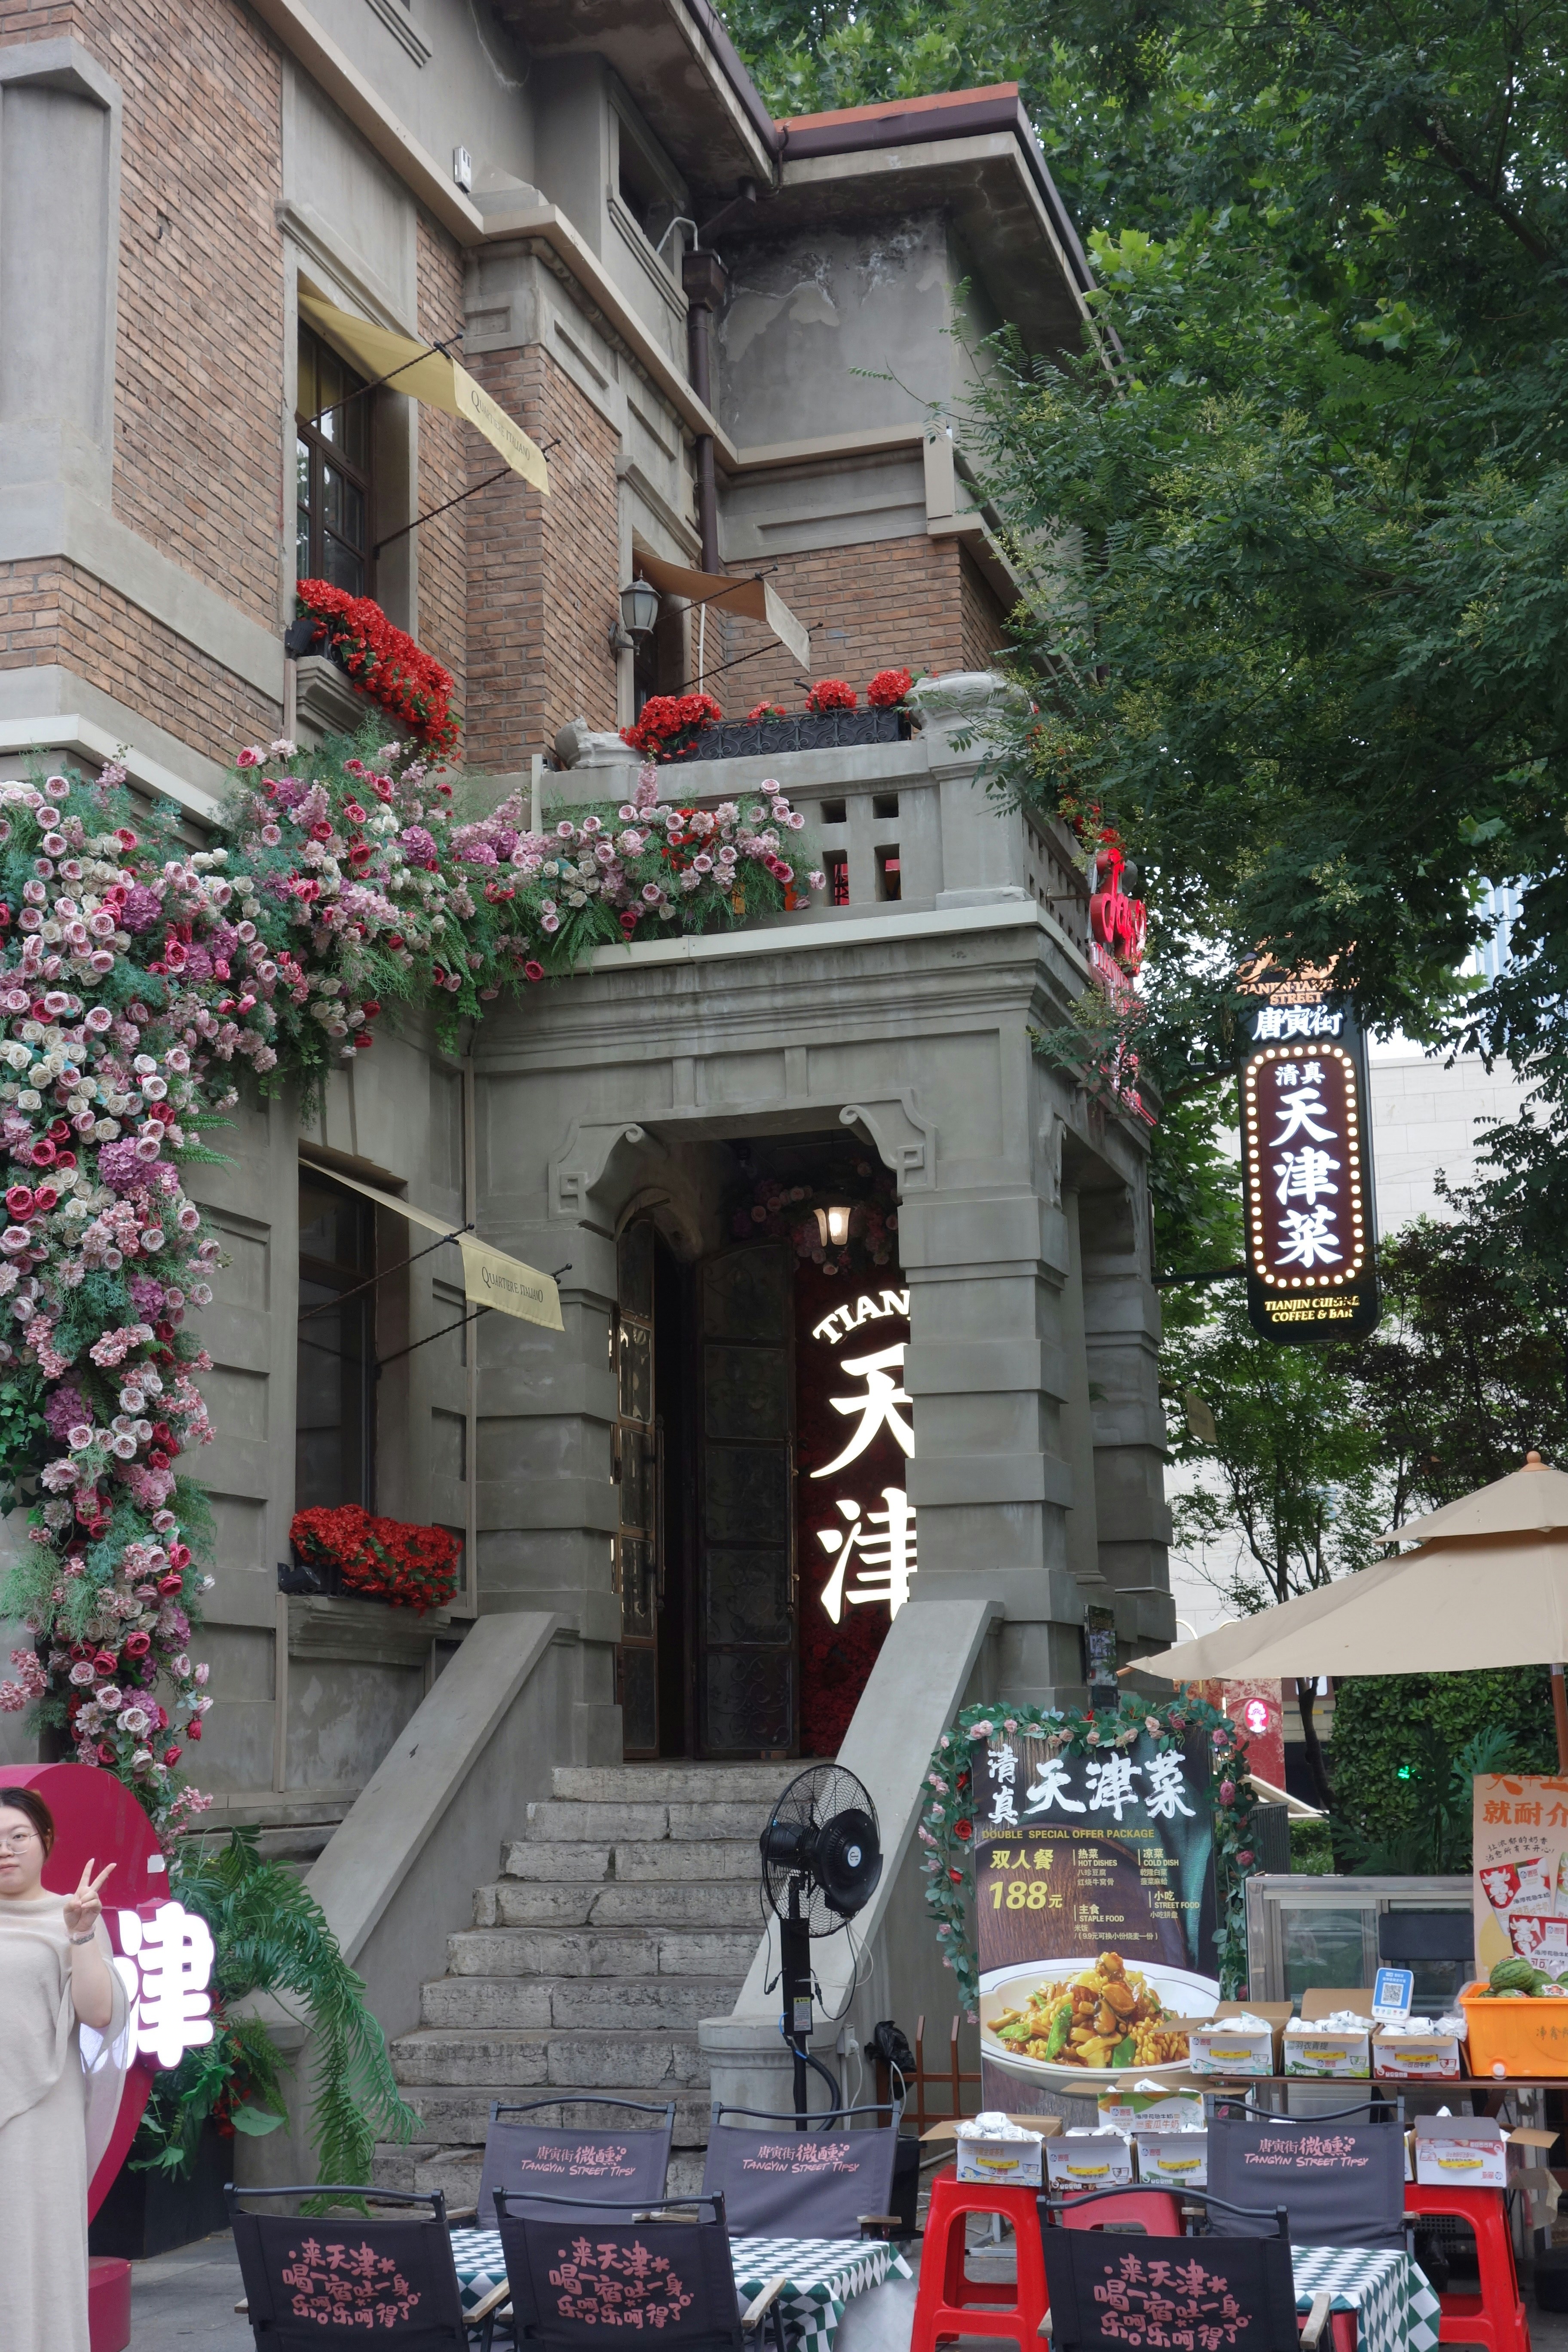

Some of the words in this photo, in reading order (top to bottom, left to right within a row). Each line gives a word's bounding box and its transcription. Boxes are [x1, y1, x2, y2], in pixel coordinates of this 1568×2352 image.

[506, 430, 530, 460] ITALIANO
[1270, 992, 1323, 1005] STREET
[1252, 1004, 1343, 1040] 唐寅街
[1274, 1061, 1326, 1086] 清真
[1268, 1087, 1344, 1269] 天津菜
[481, 1266, 518, 1293] QUARTIERE
[520, 1284, 543, 1303] ITALIANO
[1265, 1298, 1311, 1311] TIANJIN
[812, 1289, 911, 1345] TIAN
[1272, 1310, 1315, 1322] COFFEE
[1317, 1309, 1327, 1319] &
[1329, 1309, 1353, 1319] BAR
[809, 1342, 918, 1625] 天津
[987, 1743, 1019, 1825] 清真
[1023, 1749, 1197, 1821] 天津菜
[982, 1830, 1023, 1839] DOUBLE
[1029, 1830, 1070, 1839] SPECIAL
[1072, 1829, 1104, 1838] OFFER
[1107, 1829, 1155, 1838] PACKAGE
[989, 1849, 1054, 1870] 双人餐
[1078, 1848, 1099, 1859] 热菜
[1142, 1848, 1164, 1859] 凉菜
[1077, 1868, 1106, 1877] 八珍豆腐
[1077, 1878, 1115, 1886] 红烧牛窝骨
[989, 1881, 1063, 1909] 188元
[1154, 1891, 1175, 1902] 小吃
[1079, 1904, 1099, 1915] 主食
[1150, 1911, 1178, 1919] 小吃拼盘
[1074, 1924, 1089, 1932] 米饭
[1145, 2119, 1179, 2129] 蜜瓜牛奶
[521, 2159, 565, 2173] TANGYIN
[570, 2165, 608, 2175] STREET
[610, 2166, 636, 2177] TIPSY
[743, 2159, 788, 2171] TANGYIN
[791, 2162, 830, 2173] STREET
[832, 2161, 860, 2172] TIPSY
[1244, 2153, 1292, 2165] TANGYIN
[1296, 2156, 1338, 2167] STREET
[1340, 2156, 1369, 2167] TIPSY
[301, 2237, 379, 2279] 来天津
[571, 2236, 652, 2279] 来天津
[1119, 2252, 1210, 2299] 来天津
